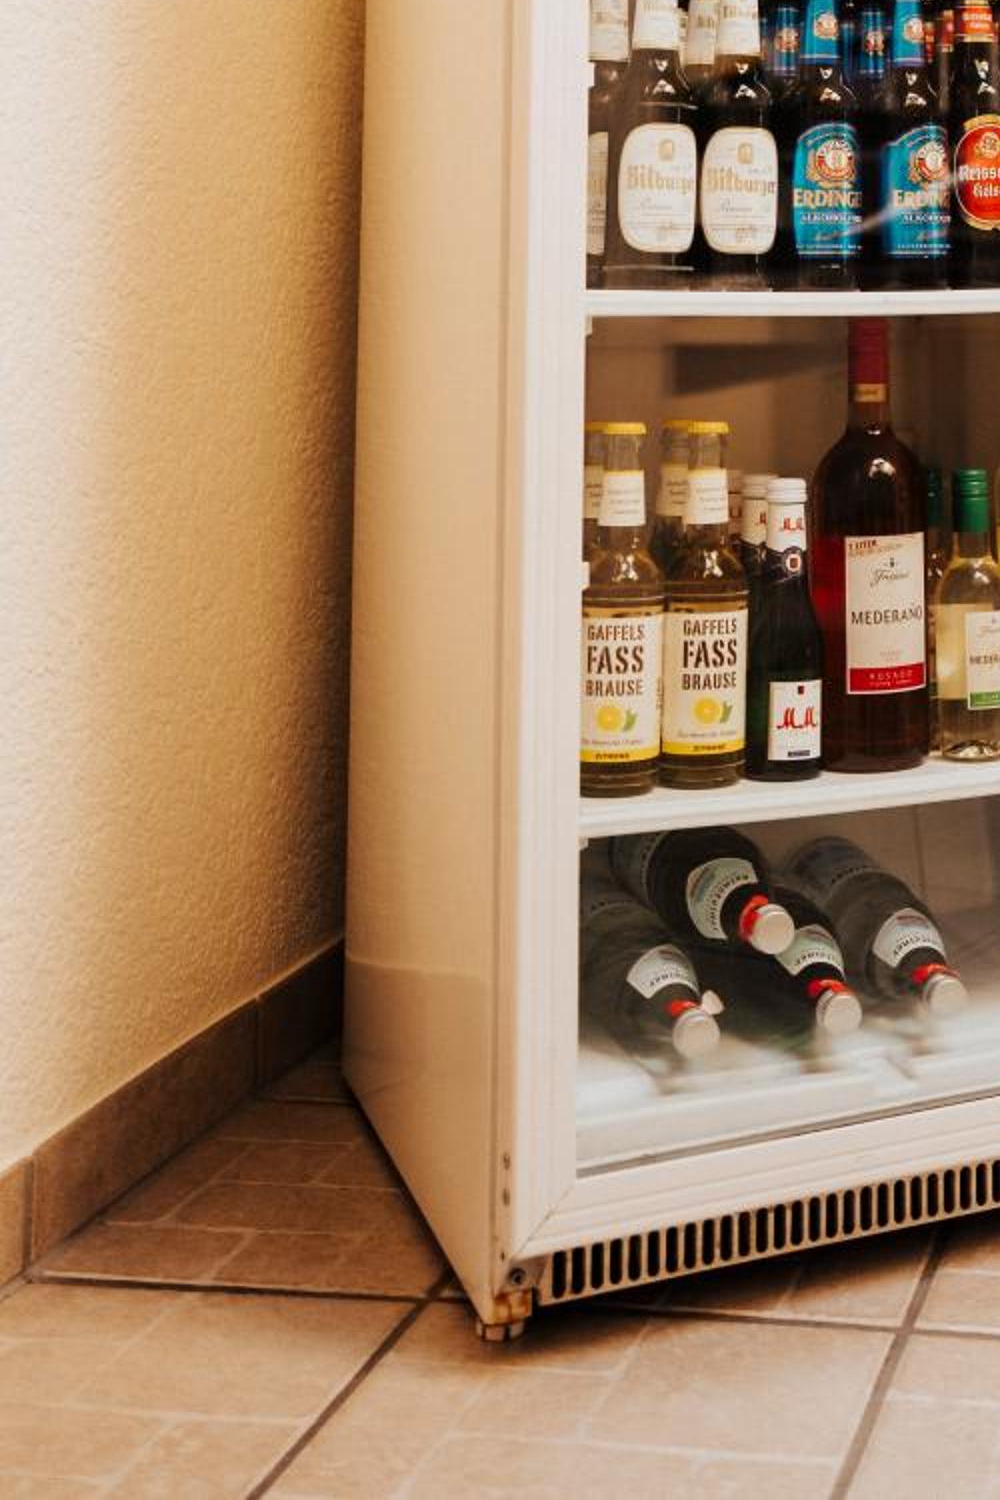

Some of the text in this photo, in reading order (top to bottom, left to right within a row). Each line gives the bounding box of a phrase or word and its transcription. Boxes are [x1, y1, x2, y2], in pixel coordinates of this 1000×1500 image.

[587, 623, 645, 642] GAFFELS
[682, 616, 737, 637] GAFFELS
[586, 645, 644, 675] FASS
[682, 638, 737, 668] FASS
[585, 678, 644, 697] BRAUSE
[681, 671, 737, 691] BRAUSE
